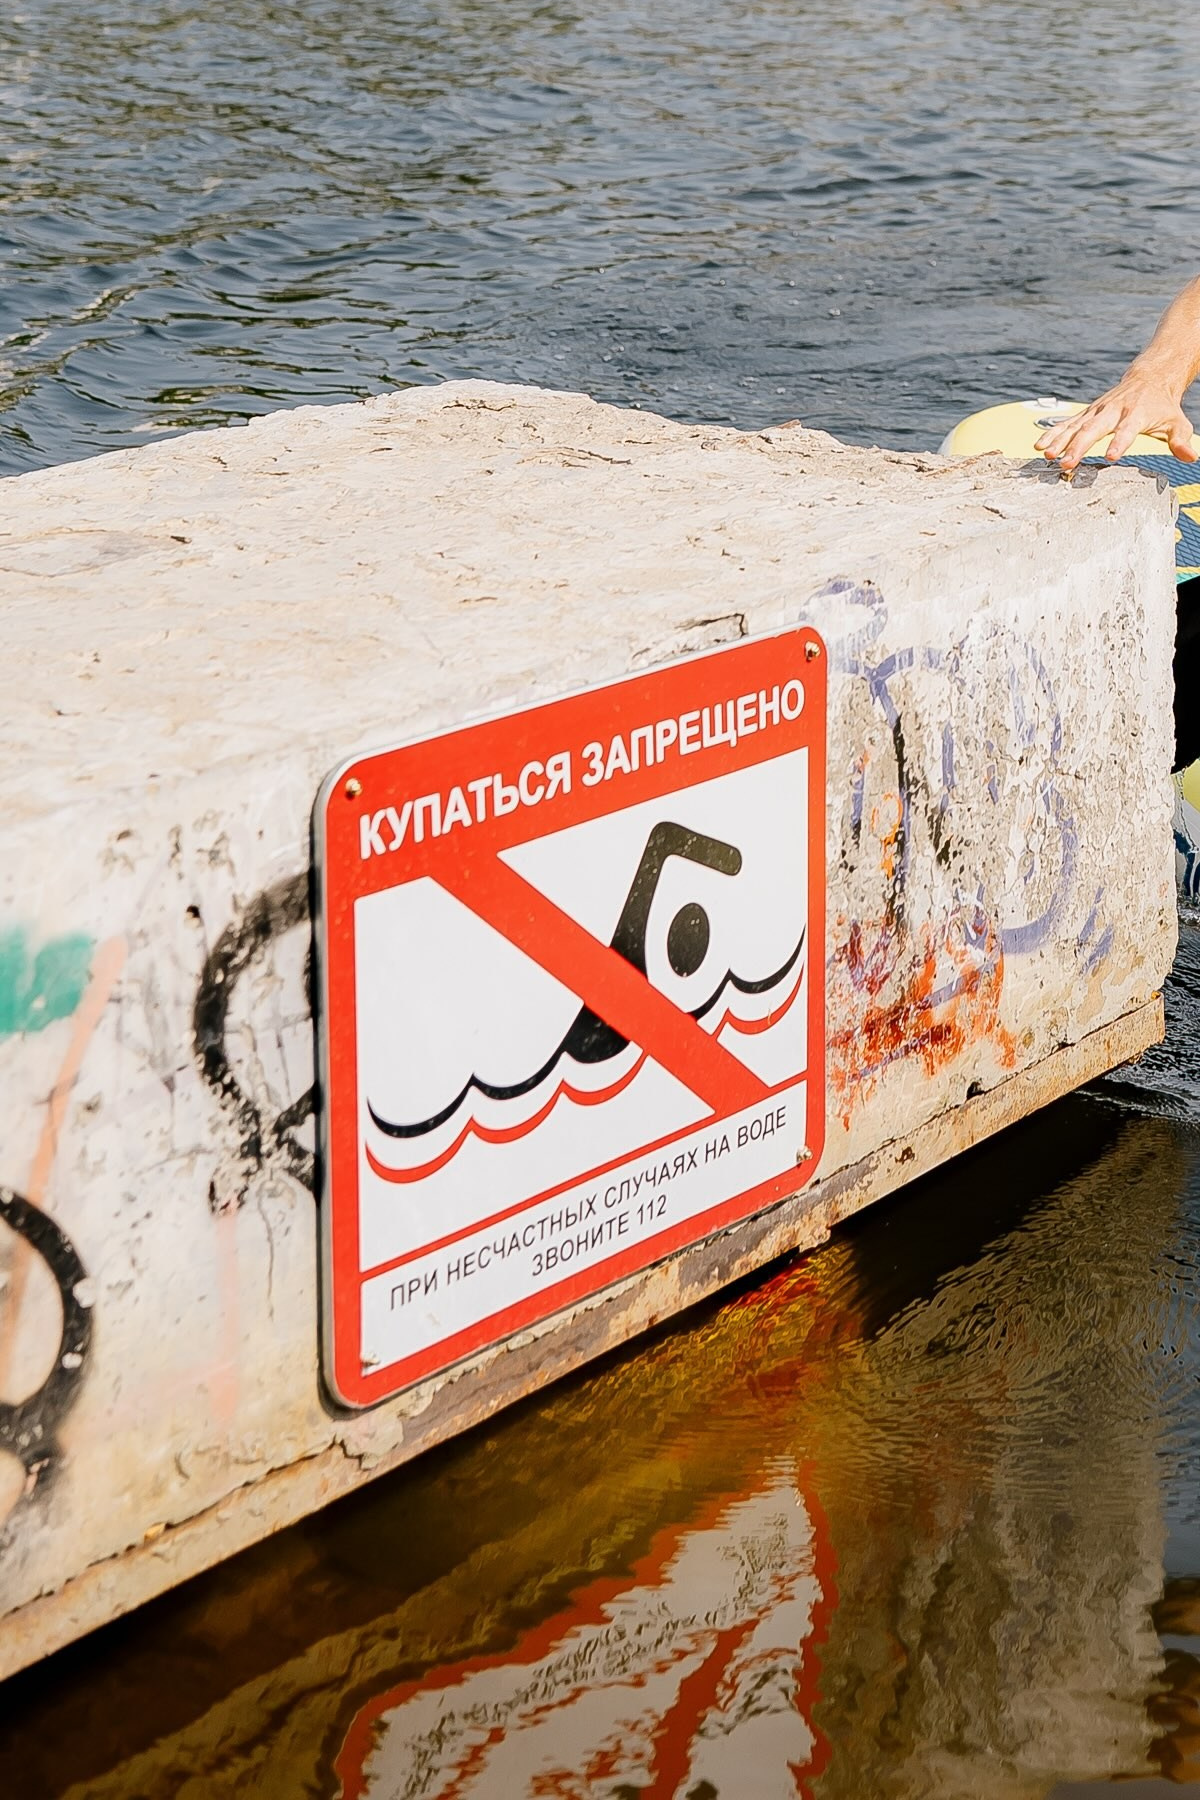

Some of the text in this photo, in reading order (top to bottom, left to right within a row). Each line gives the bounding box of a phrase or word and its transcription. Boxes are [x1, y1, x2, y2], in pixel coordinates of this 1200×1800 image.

[359, 678, 805, 860] КУПАТЬСЯ ЗАПРЕЩЕНО
[390, 1105, 787, 1311] ПРИ НЕСЧАСТНЫХ СЛУЧАЯХ НА ВОДЕ
[532, 1194, 668, 1277] ЗВОНИТЕ 112
